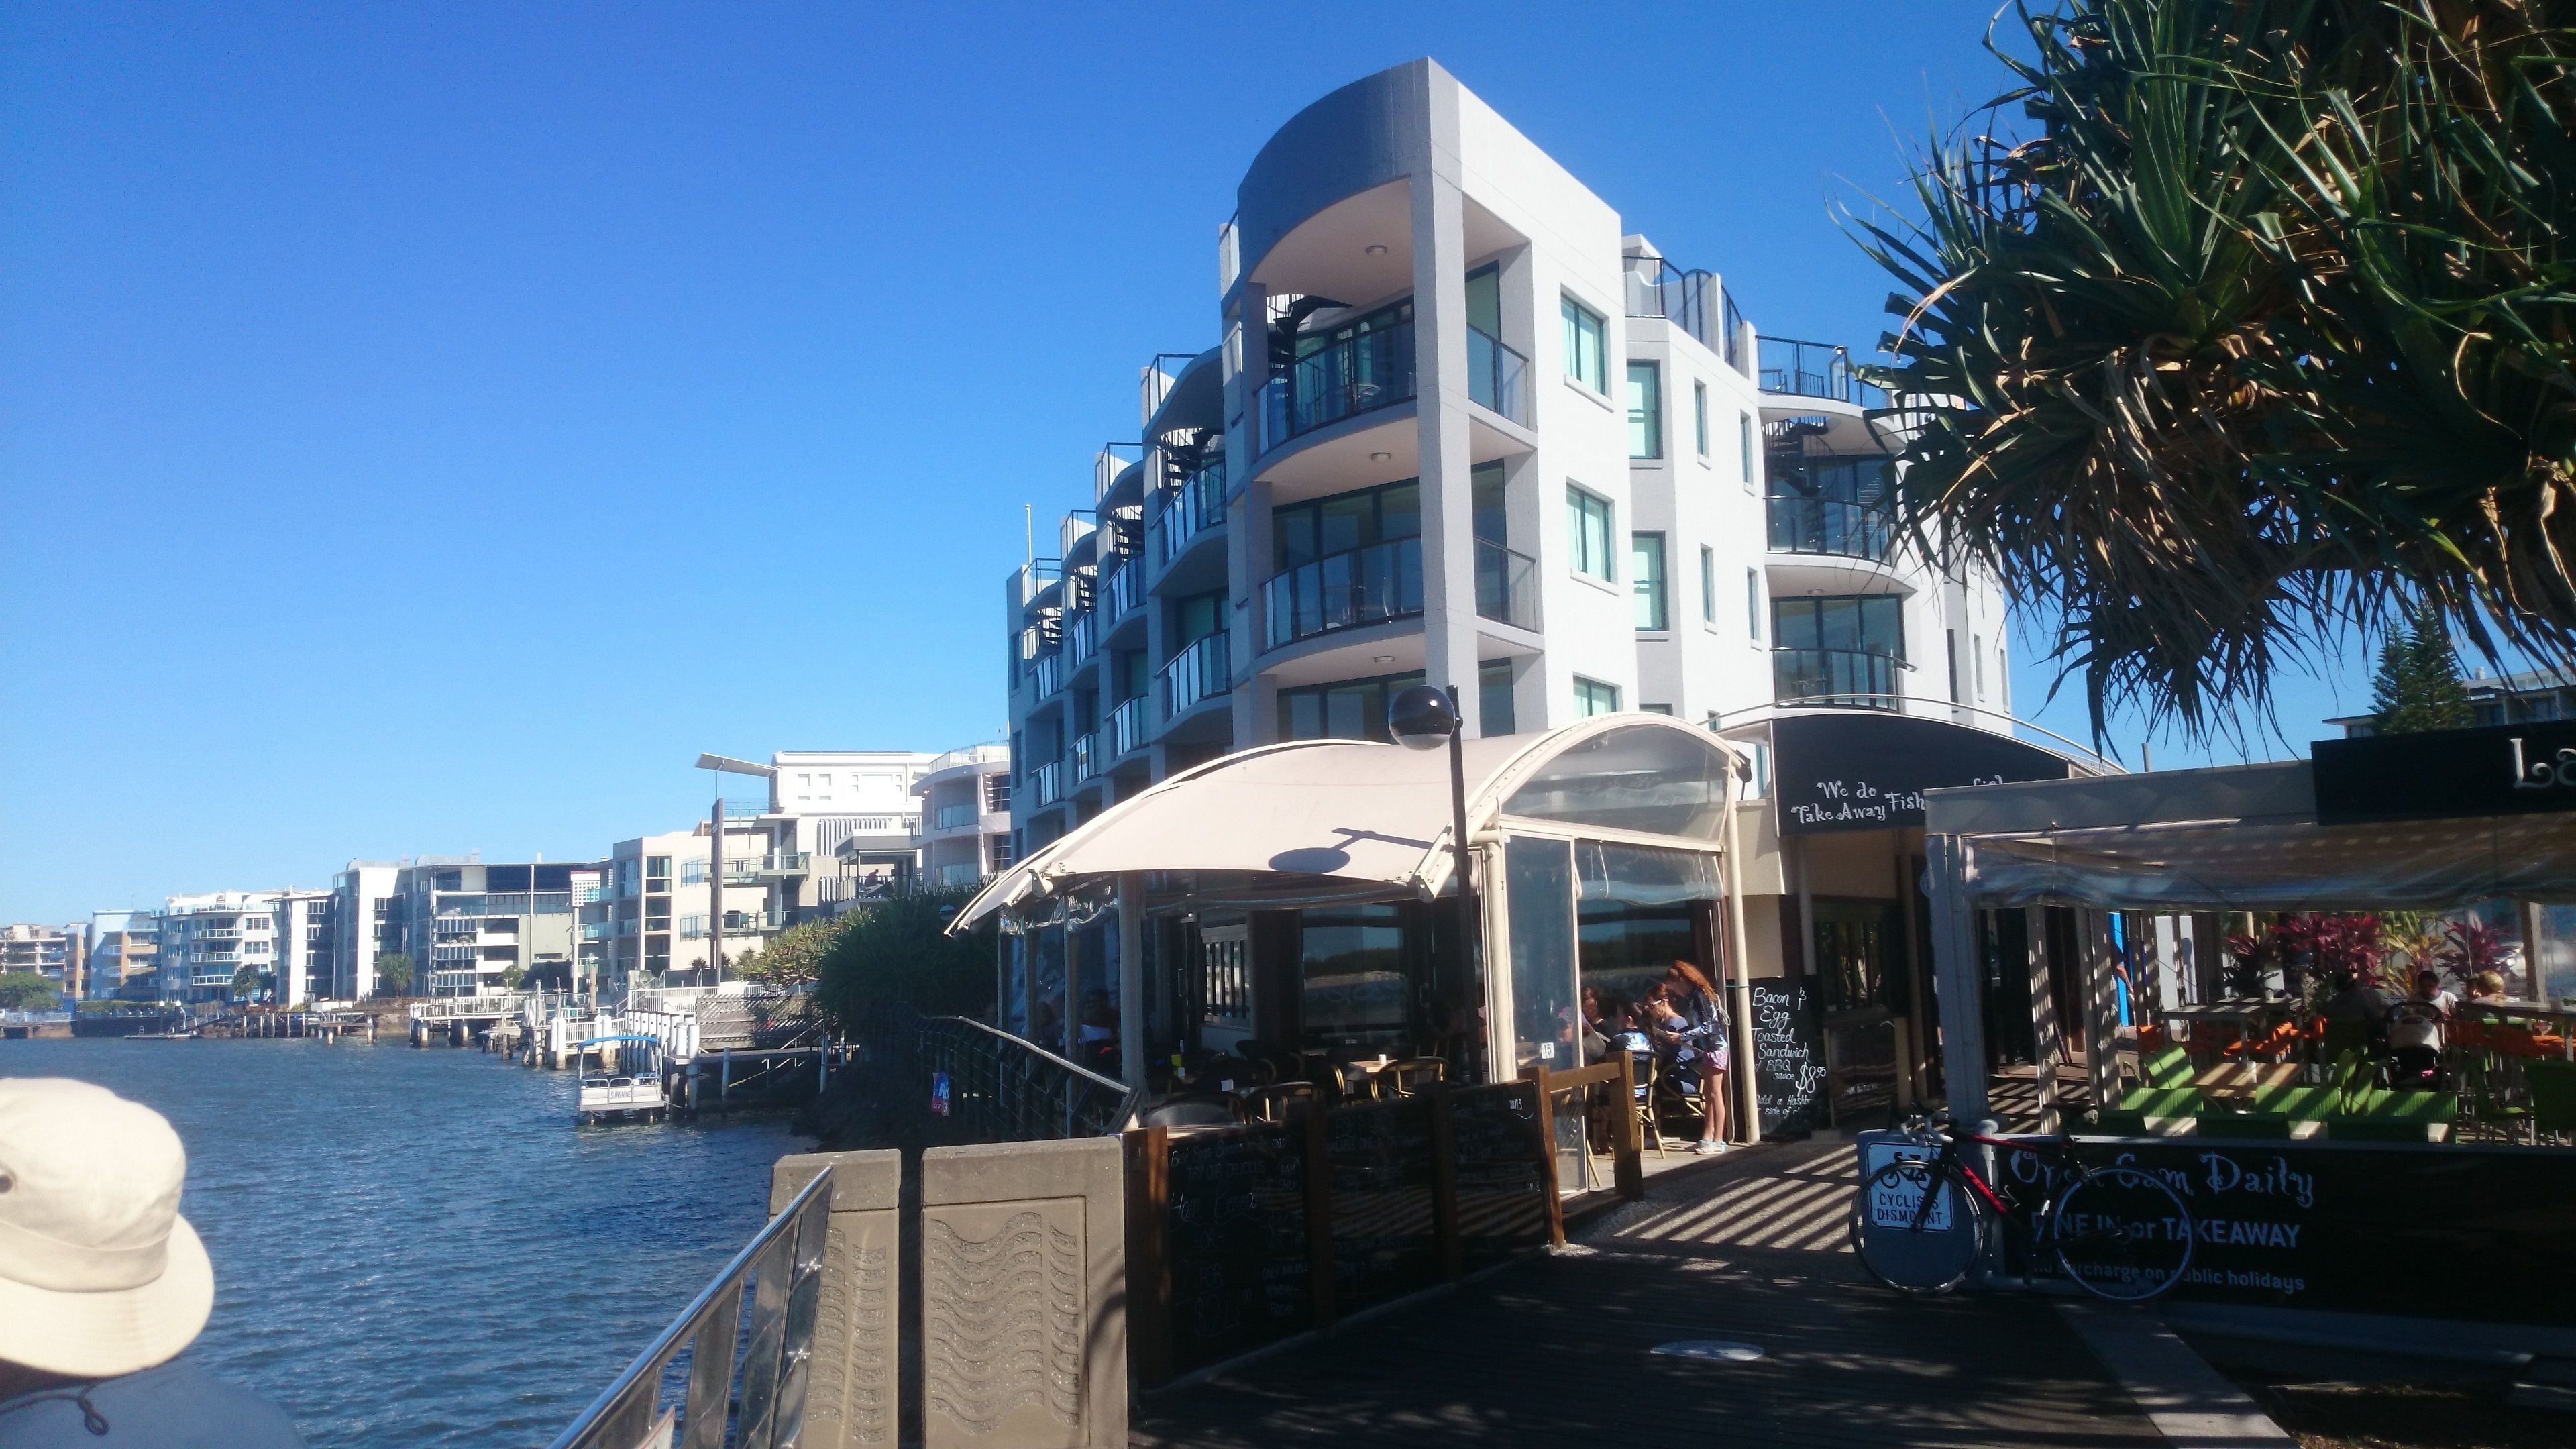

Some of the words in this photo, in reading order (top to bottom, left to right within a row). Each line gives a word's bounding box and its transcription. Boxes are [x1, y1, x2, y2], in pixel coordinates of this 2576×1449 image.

[1816, 780, 1848, 798] We
[1856, 782, 1876, 798] do
[1884, 792, 1925, 812] Fish
[1790, 803, 1833, 824] Take
[1836, 802, 1886, 821] Away
[1752, 987, 1790, 1006] Bacon
[1760, 1005, 1791, 1030] Egg
[1751, 1028, 1796, 1044] Toasted
[1544, 1044, 1552, 1054] 15
[1758, 1042, 1811, 1062] Sandwich
[1766, 1059, 1791, 1071] BBQ
[611, 1091, 632, 1099] SUNSHINE
[1765, 1107, 1780, 1115] side
[2199, 1150, 2314, 1208] Daily
[1880, 1193, 1939, 1209] CYCLISS
[1877, 1208, 1943, 1224] DISMONT
[2131, 1220, 2157, 1239] or
[2161, 1216, 2302, 1248] TAKEAWAY
[2227, 1269, 2306, 1295] holidays
